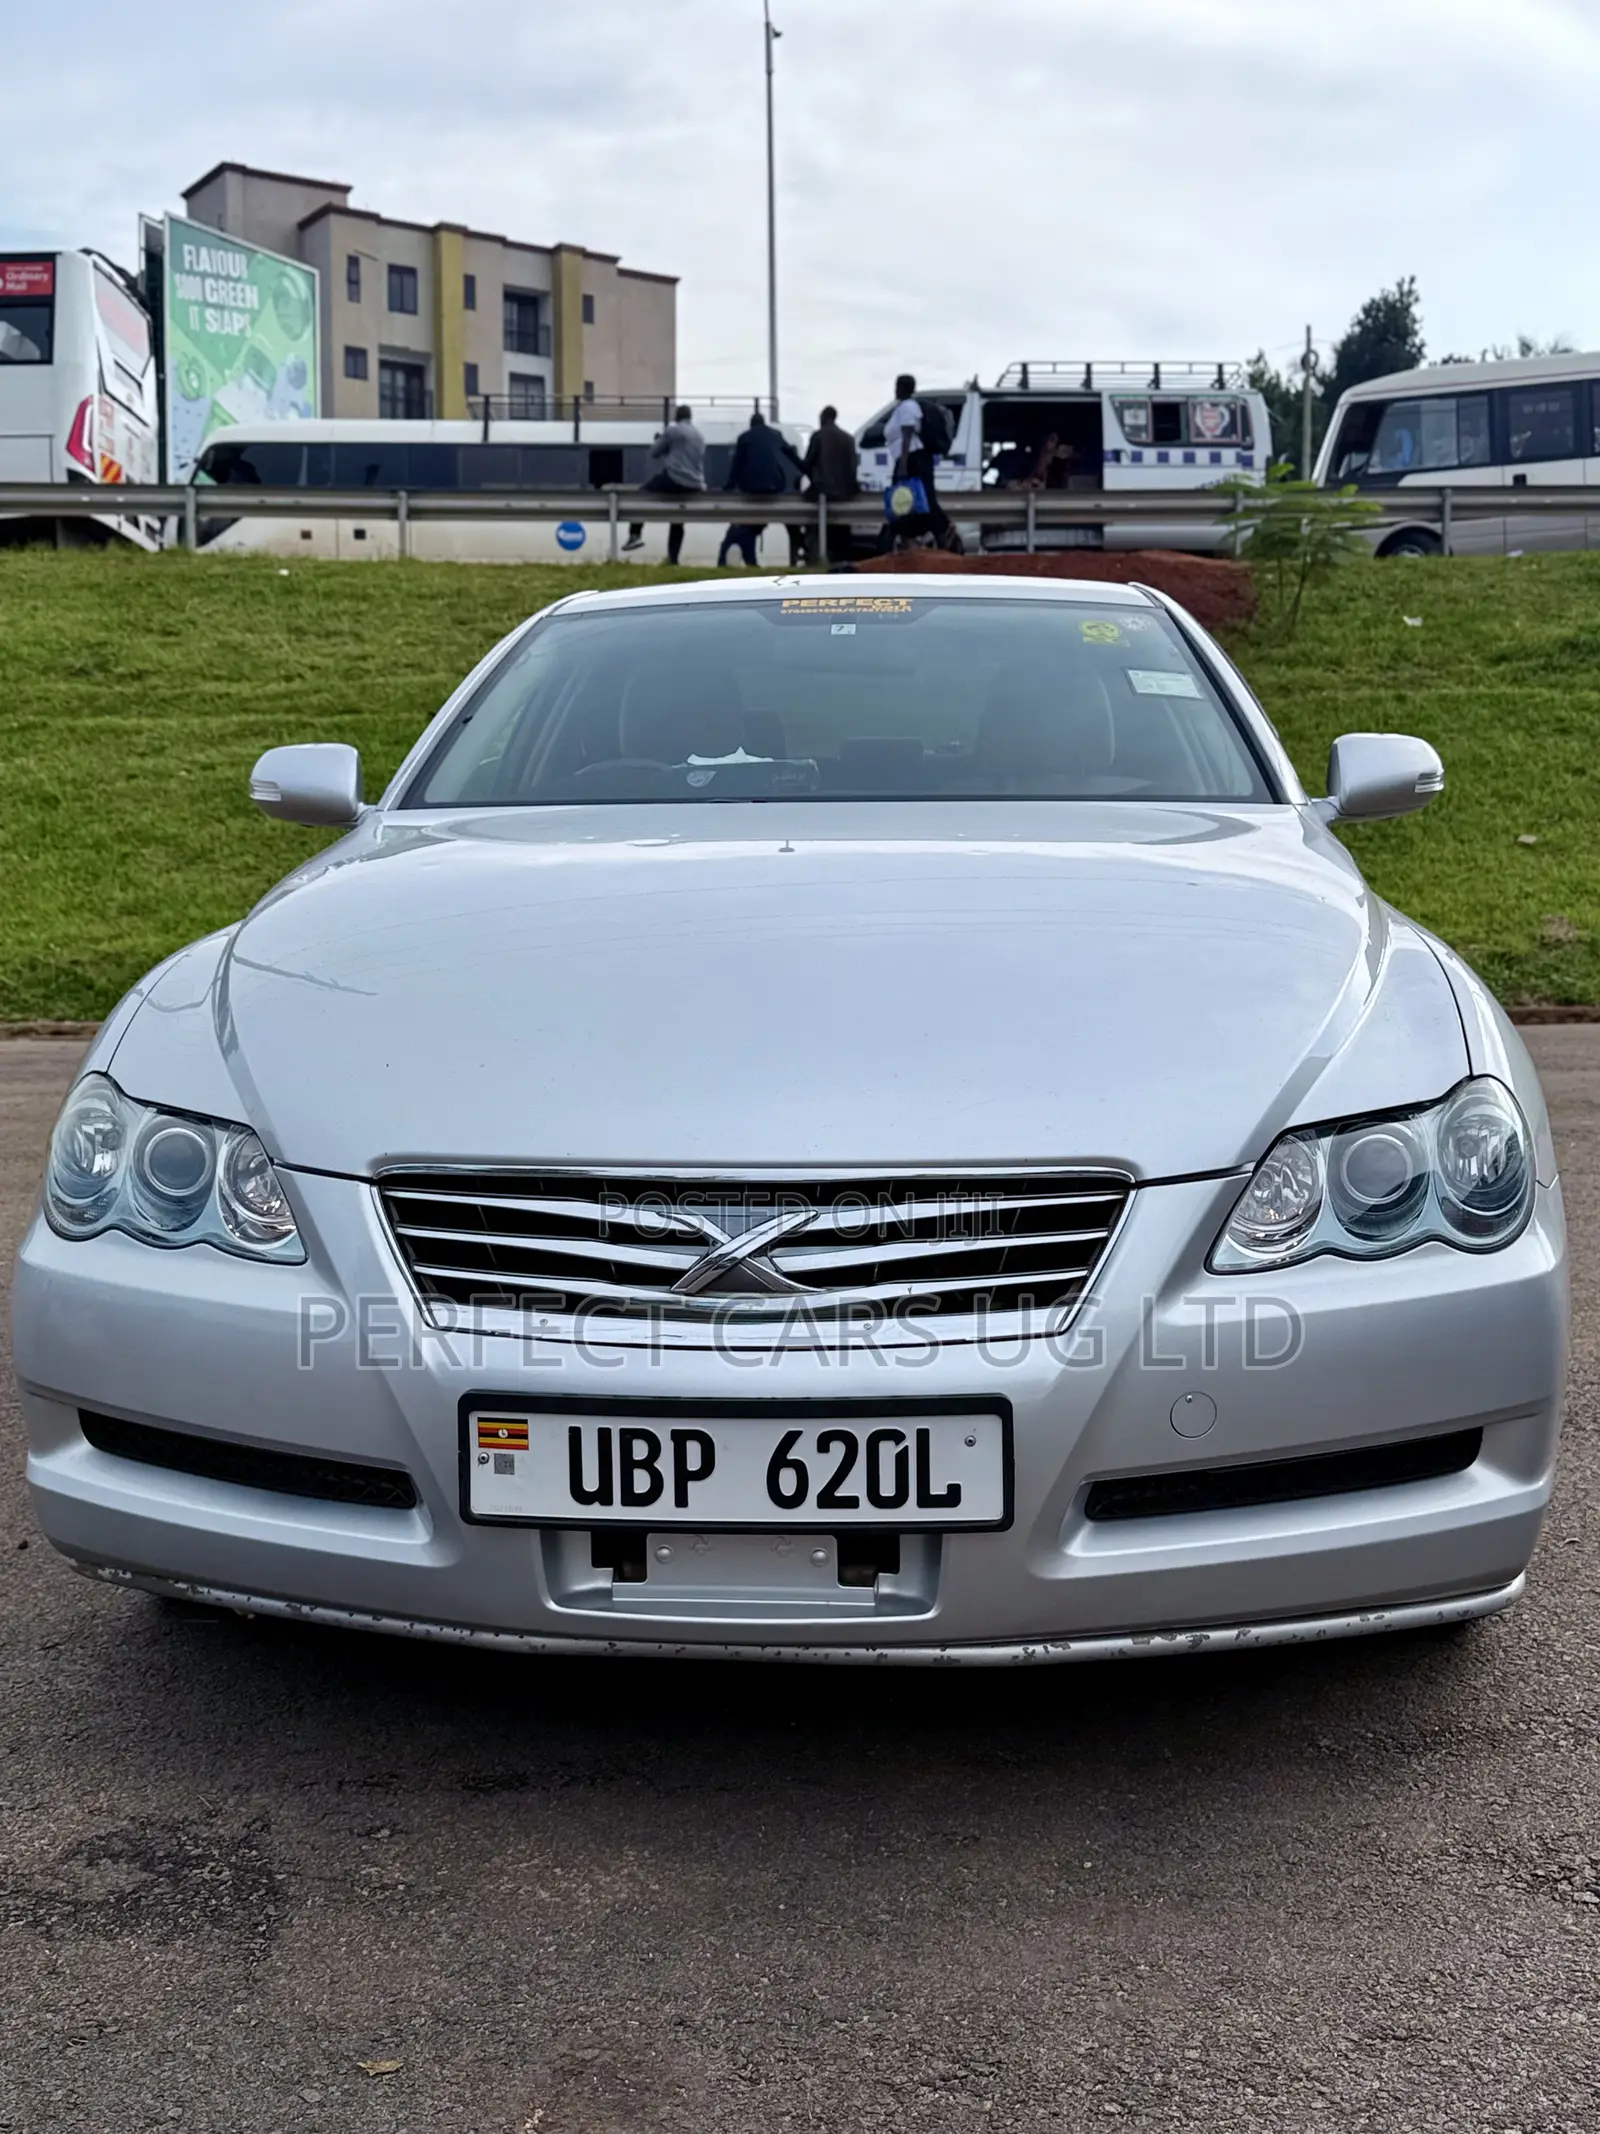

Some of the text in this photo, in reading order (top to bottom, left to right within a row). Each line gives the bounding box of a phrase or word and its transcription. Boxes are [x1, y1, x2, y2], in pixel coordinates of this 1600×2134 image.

[204, 276, 260, 311] GREEN
[189, 305, 200, 332] IT
[782, 599, 913, 608] PERFECT
[567, 1425, 963, 1510] UBP 620L
